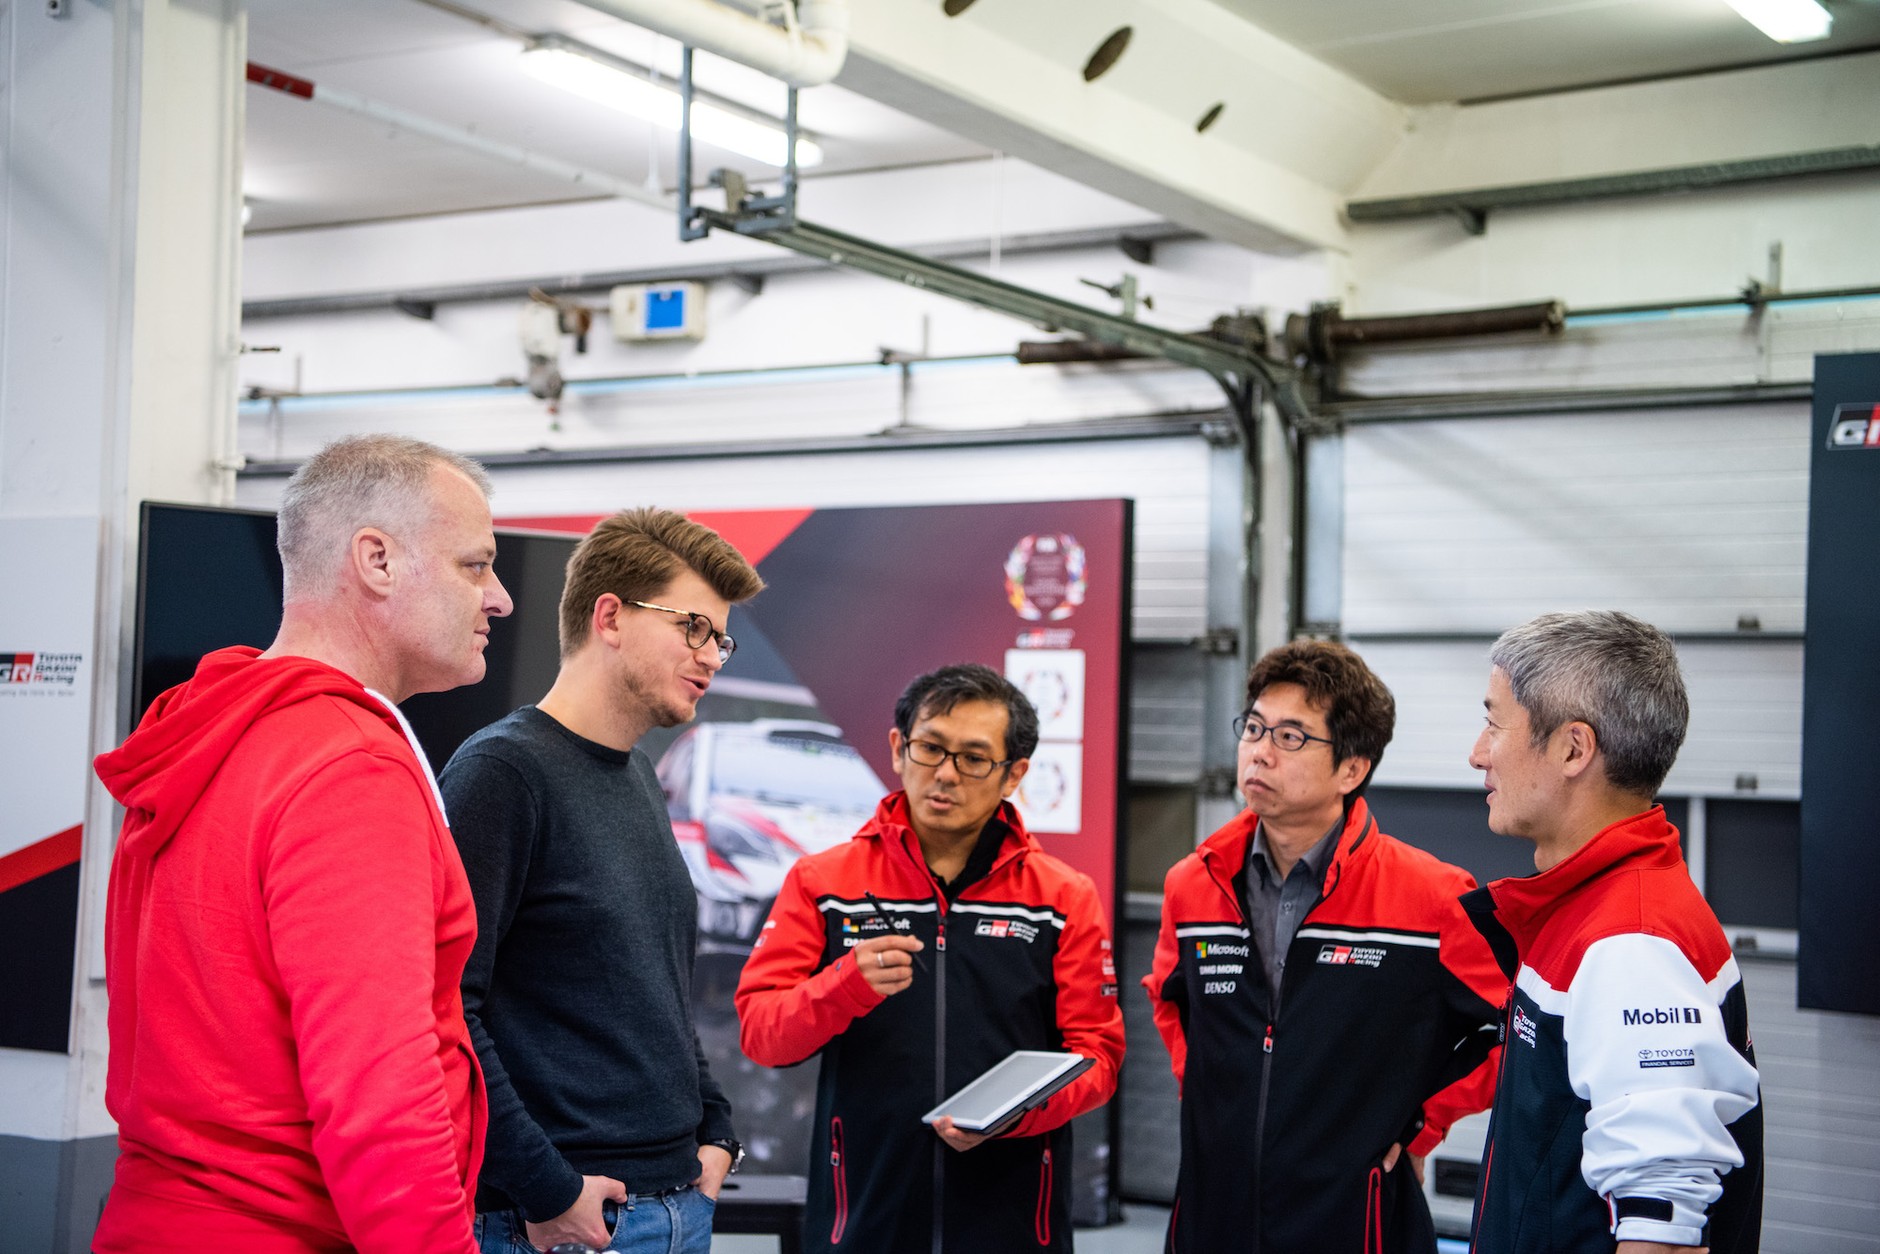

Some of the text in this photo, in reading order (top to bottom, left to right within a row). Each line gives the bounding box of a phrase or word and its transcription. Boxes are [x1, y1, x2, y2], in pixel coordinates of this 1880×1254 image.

[1207, 943, 1250, 958] Microsoft
[1353, 947, 1387, 956] TOYOTA
[1317, 950, 1348, 963] GR
[1349, 952, 1383, 961] GAZOO
[1347, 958, 1381, 968] Racing
[1217, 964, 1243, 975] MORI
[1204, 981, 1237, 994] DENSO
[1623, 1007, 1699, 1026] Mobil 1
[1655, 1048, 1695, 1058] TOYOTA
